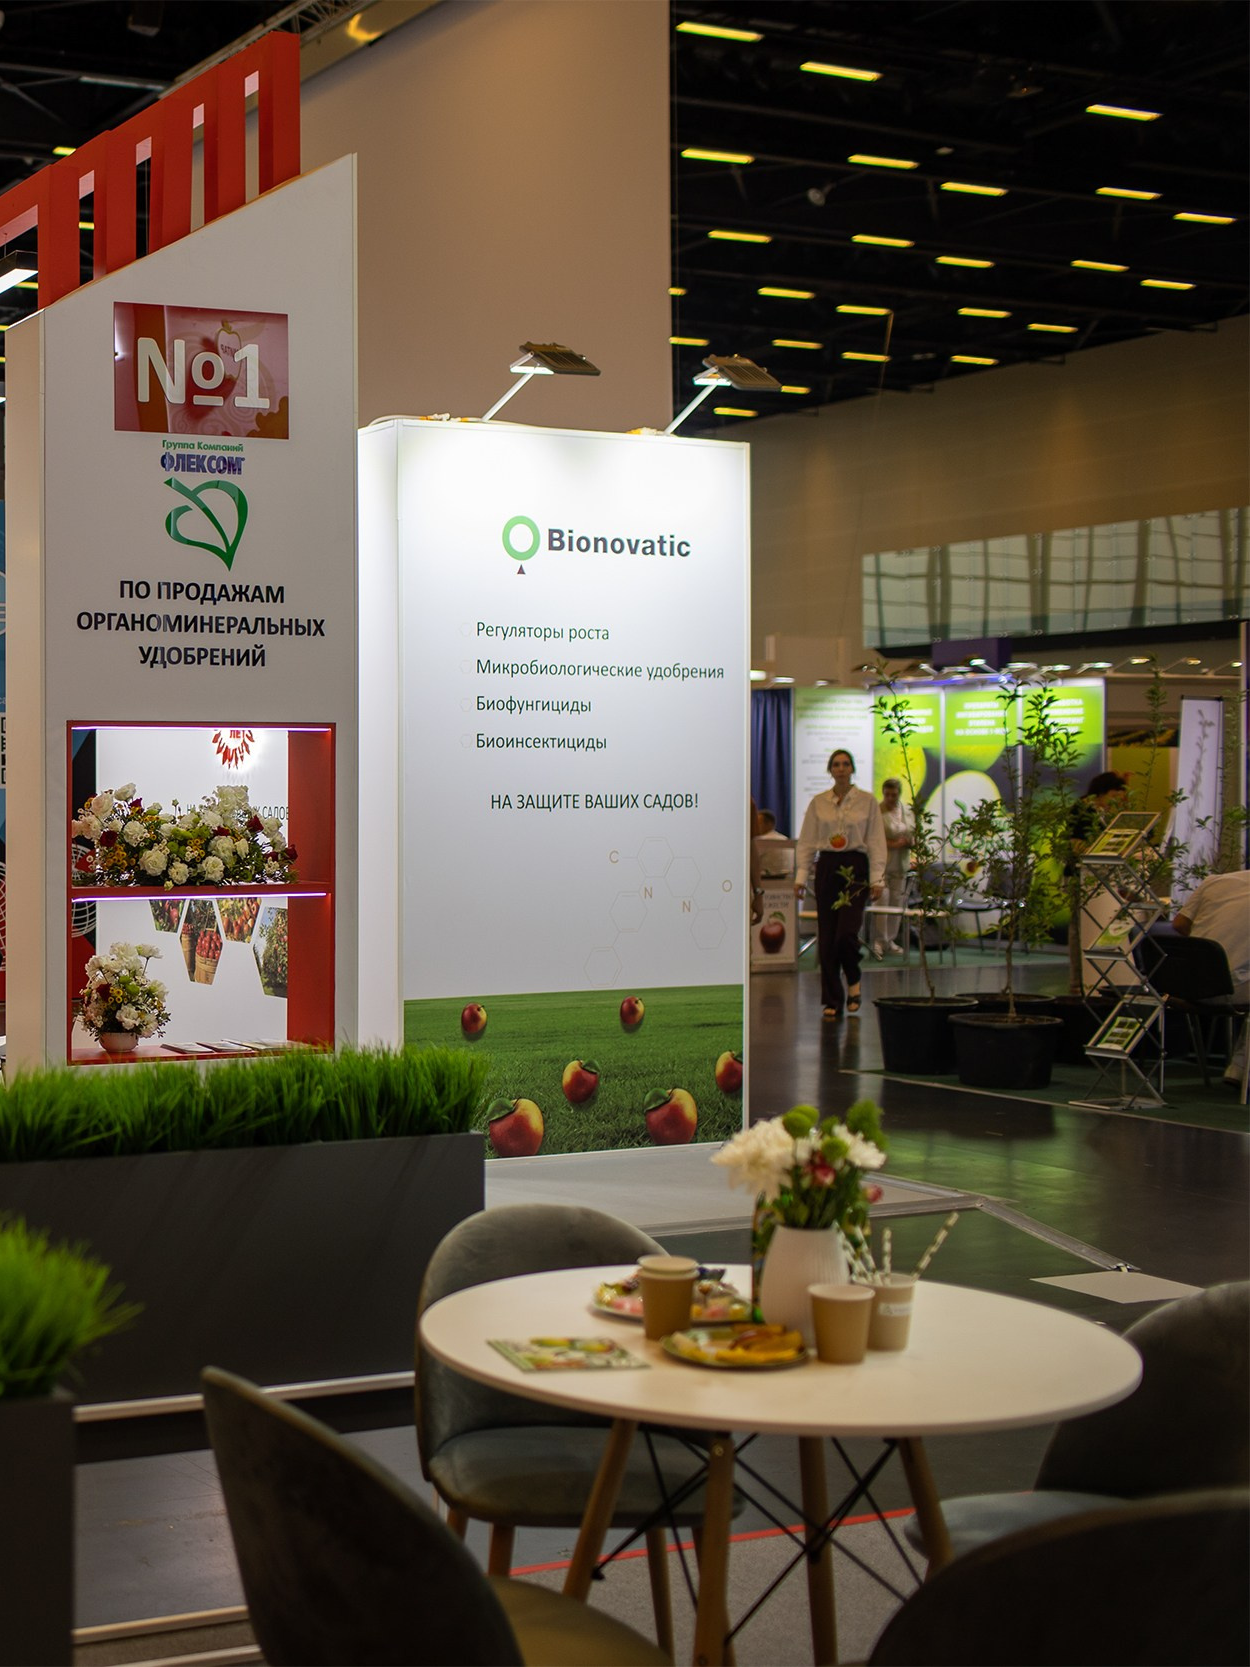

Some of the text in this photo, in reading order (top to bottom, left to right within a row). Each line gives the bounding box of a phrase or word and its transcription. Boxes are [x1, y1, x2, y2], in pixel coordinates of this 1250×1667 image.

[162, 439, 244, 452] Группа Компаний
[160, 451, 244, 475] ФЛЕКСОМ
[547, 528, 691, 557] Bionovatic
[119, 580, 285, 605] ПО ПРОДАЖАМ
[76, 611, 326, 637] ОРГАНОМИНЕРАЛЬНЫХ
[476, 621, 610, 643] Регуляторы роста
[138, 644, 266, 669] УДОБРЕНИЙ
[476, 658, 725, 682] Микробиологические удобрения
[476, 695, 592, 715] Биофунгициды
[476, 733, 607, 752] Биоинсектициды
[491, 793, 699, 812] НА ЗАЩИТЕ ВАШИХ САДОВ!
[644, 886, 653, 899] N
[682, 900, 691, 912] N
